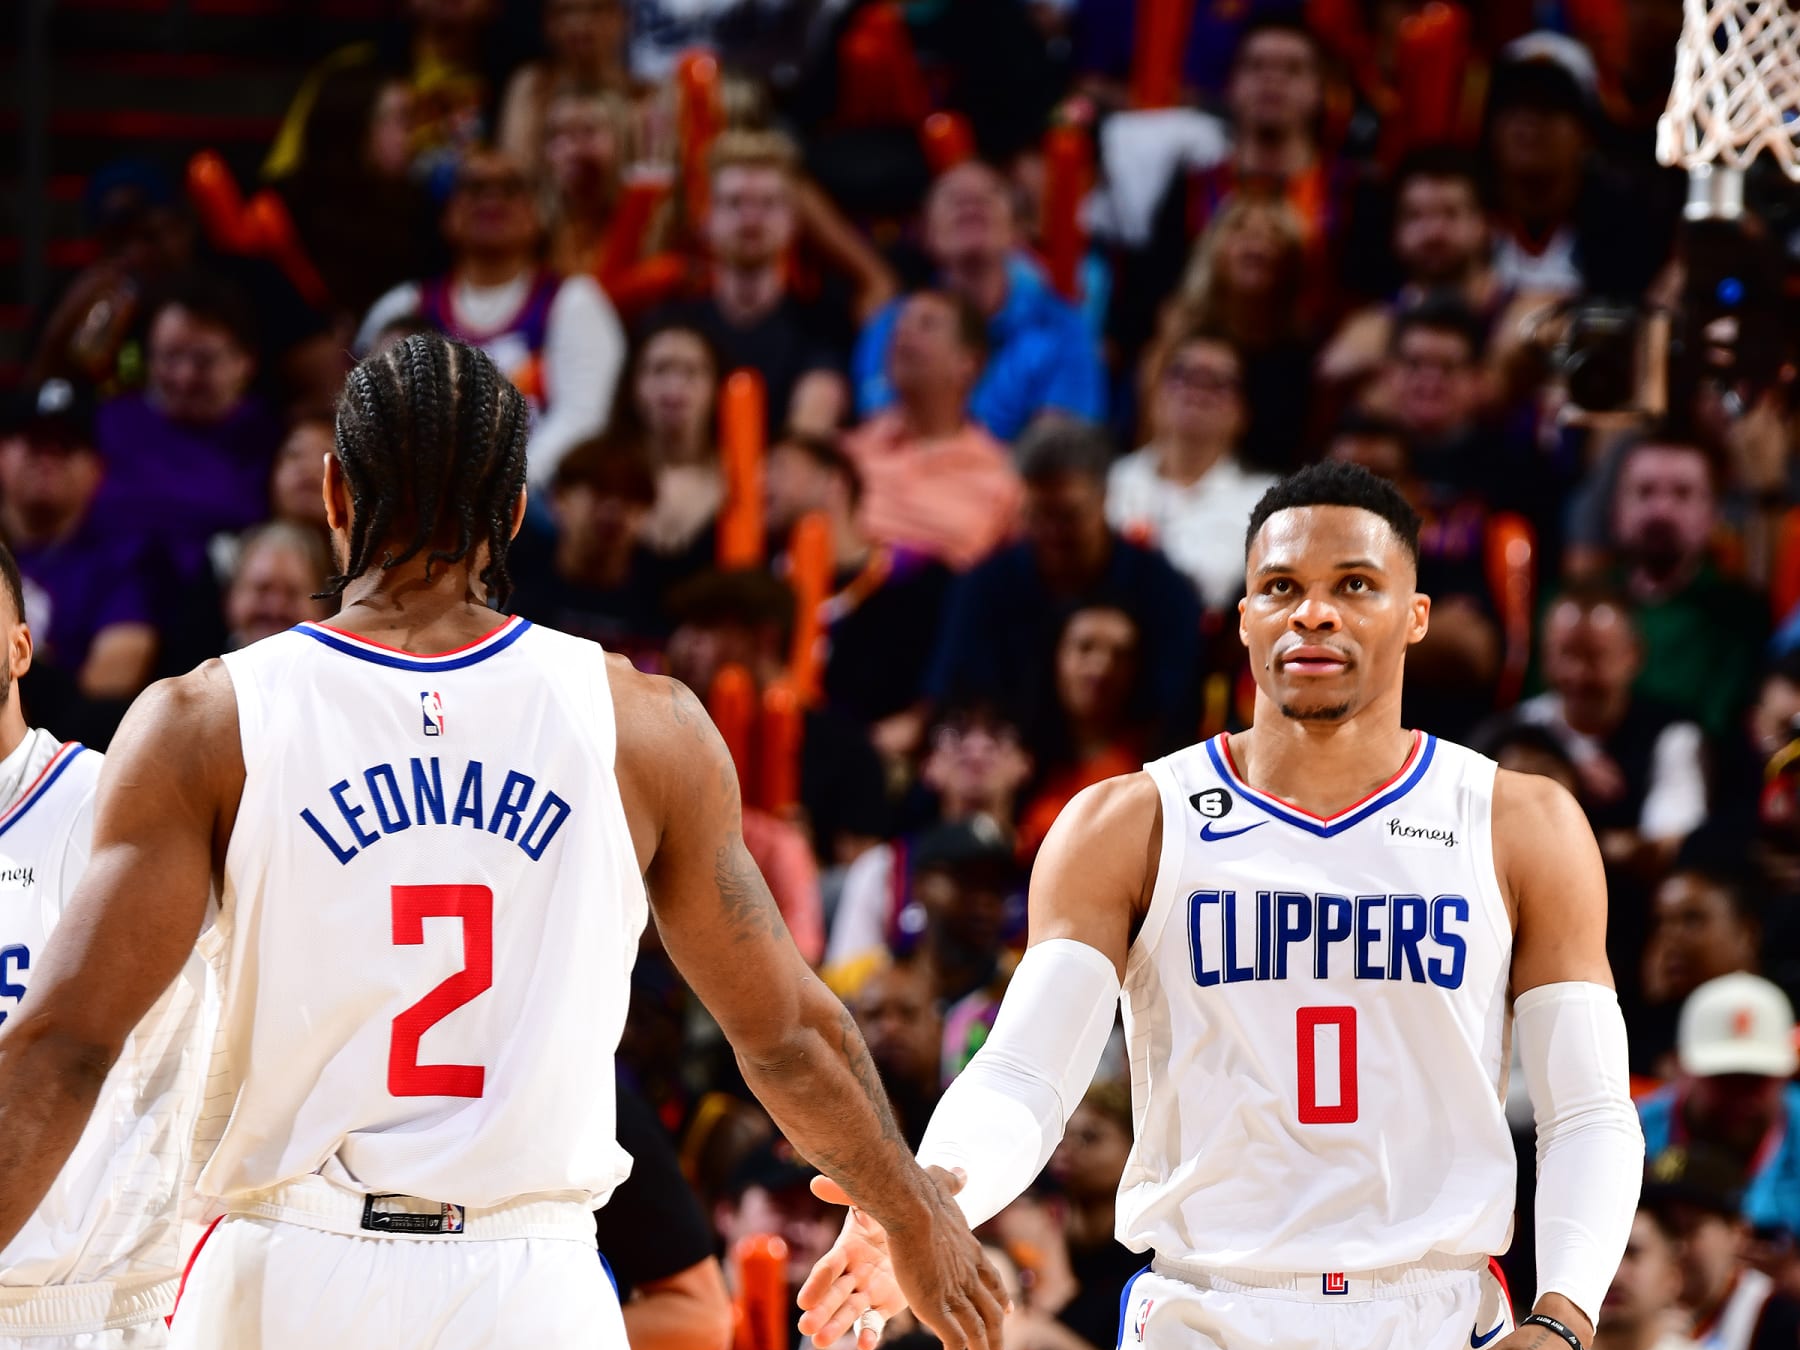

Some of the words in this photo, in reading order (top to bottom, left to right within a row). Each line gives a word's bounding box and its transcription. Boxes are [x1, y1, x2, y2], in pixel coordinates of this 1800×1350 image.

[299, 757, 572, 866] LEONARD
[1199, 791, 1224, 818] 6
[1386, 818, 1459, 848] honey
[387, 884, 494, 1099] 2
[1187, 889, 1470, 990] CLIPPERS
[1296, 1005, 1359, 1125] 0
